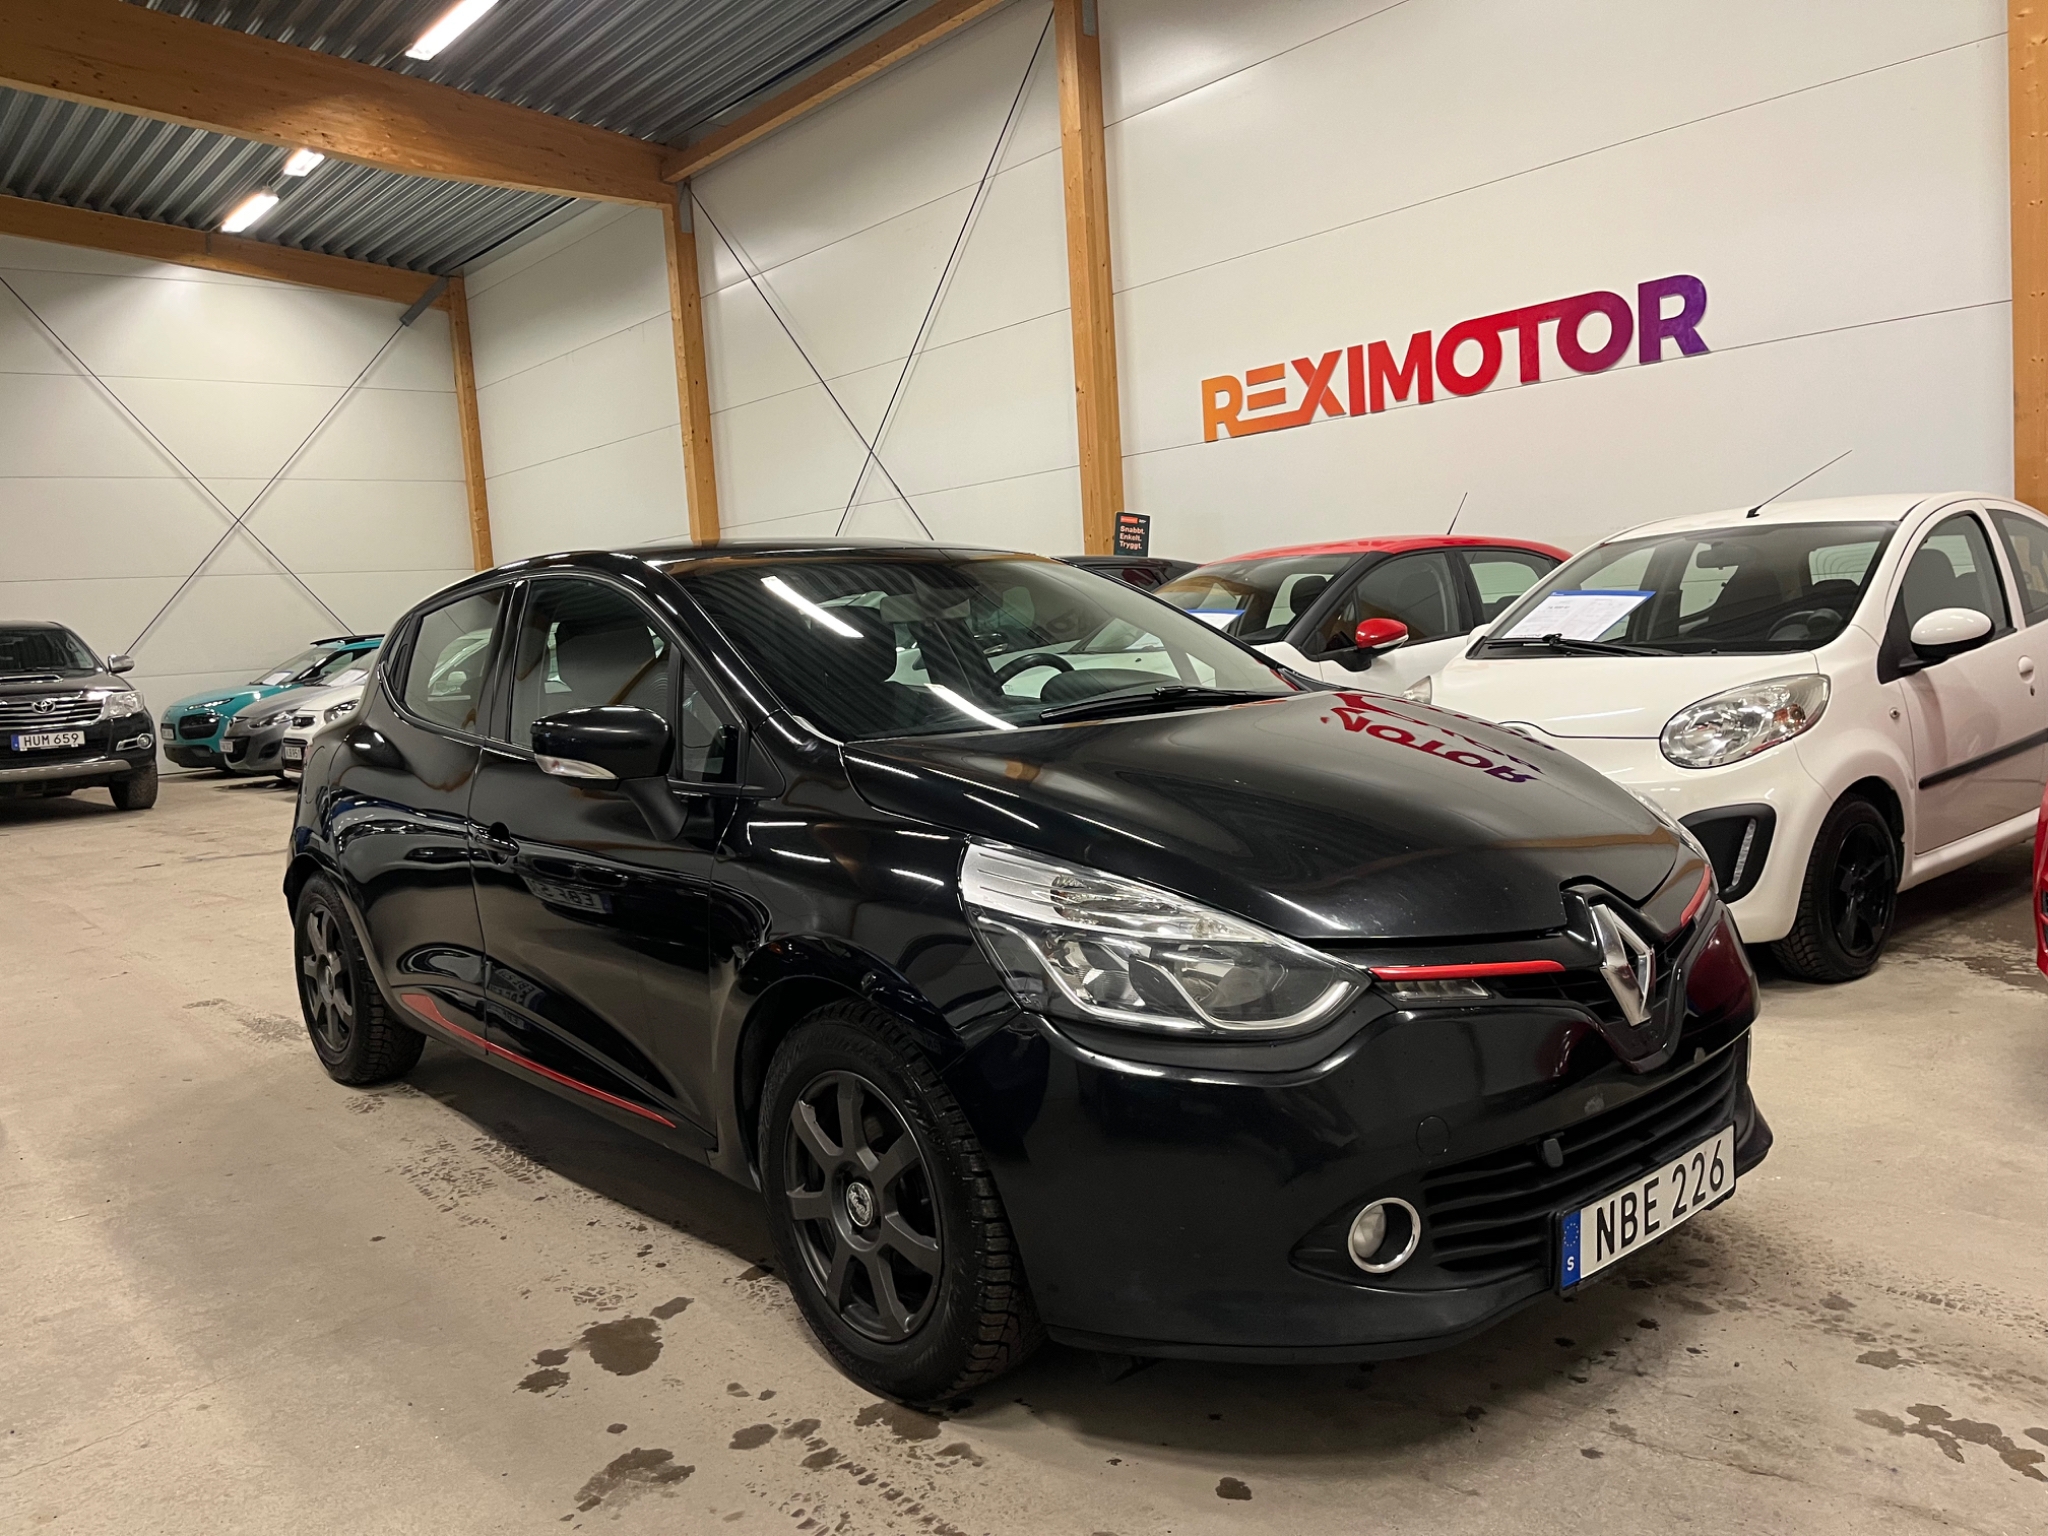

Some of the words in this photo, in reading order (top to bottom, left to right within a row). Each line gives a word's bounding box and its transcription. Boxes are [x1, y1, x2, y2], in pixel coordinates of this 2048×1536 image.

[1201, 274, 1710, 443] REXIMOTOR
[24, 735, 50, 747] HUM
[54, 733, 79, 745] 659
[1597, 1177, 1660, 1262] NBE
[1672, 1140, 1724, 1220] 226
[1567, 1256, 1575, 1271] S
